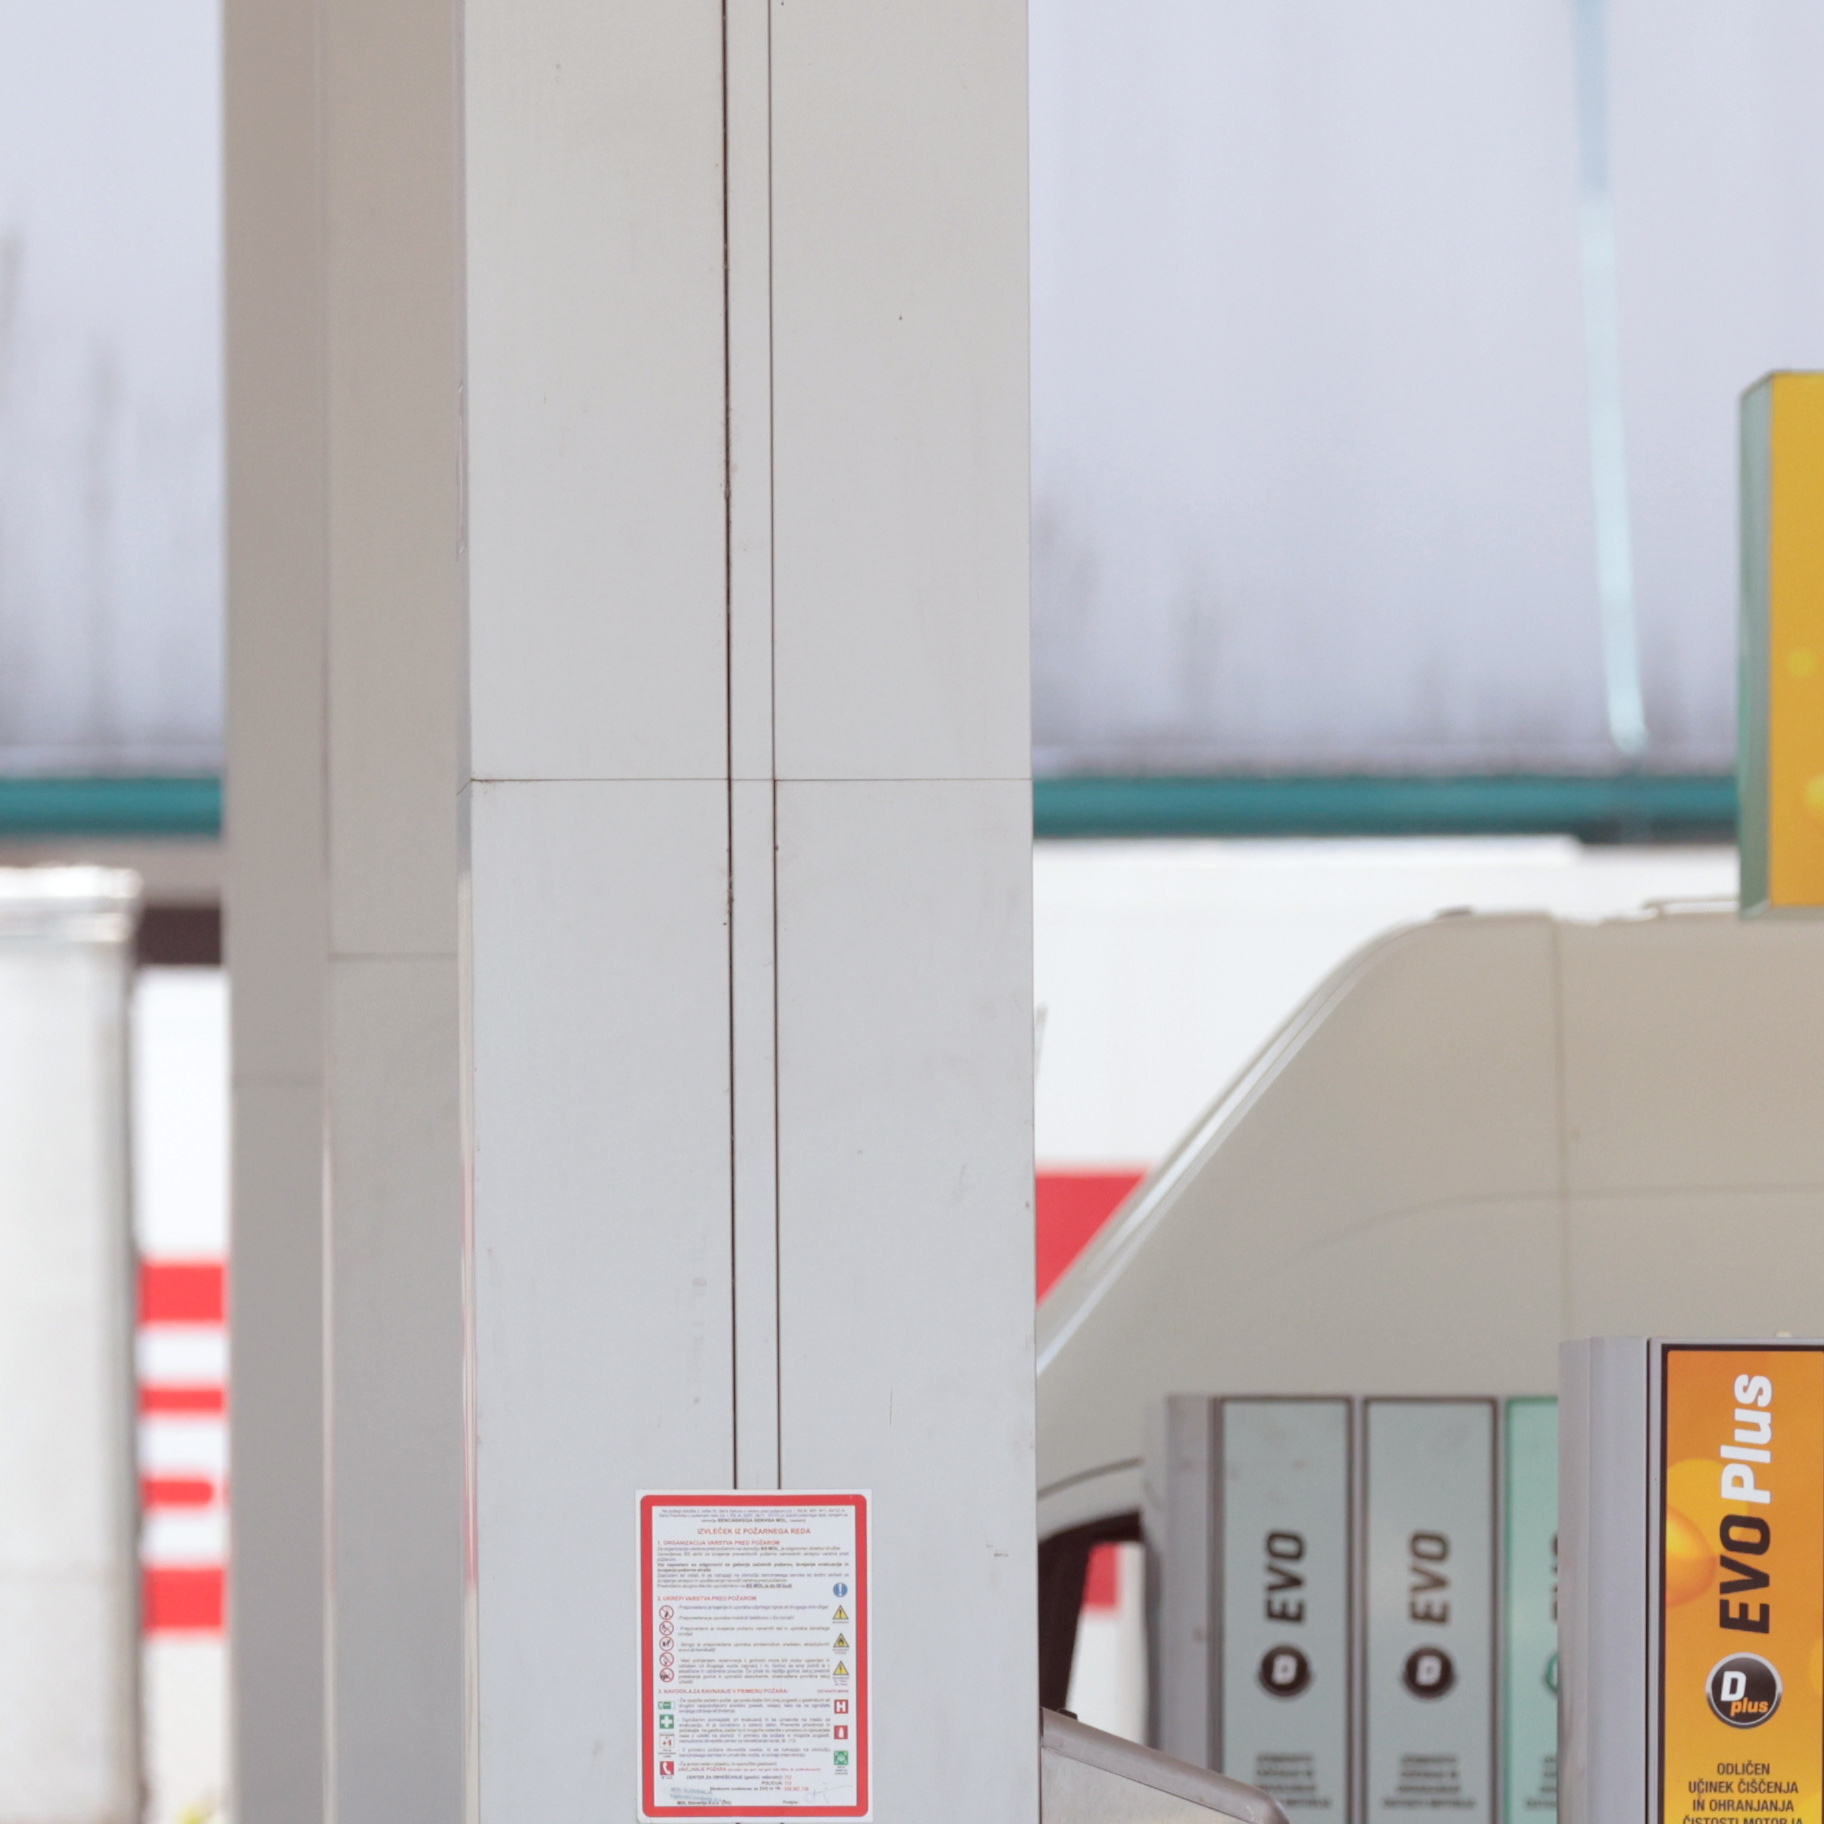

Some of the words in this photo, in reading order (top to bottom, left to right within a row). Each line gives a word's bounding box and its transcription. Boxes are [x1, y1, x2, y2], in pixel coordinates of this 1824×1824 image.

[1721, 1372, 1773, 1505] Plus
[1264, 1528, 1306, 1625] EVO
[1408, 1528, 1450, 1626] EVO
[1719, 1513, 1771, 1634] EVO
[1721, 1671, 1747, 1701] D
[1730, 1697, 1769, 1717] plus
[1716, 1759, 1771, 1776] ODLIČEN
[1688, 1777, 1734, 1795] UČINEK
[1737, 1777, 1799, 1794] ČIŠČENJA
[1692, 1798, 1706, 1812] IN
[1708, 1798, 1795, 1813] OHRANJANJA
